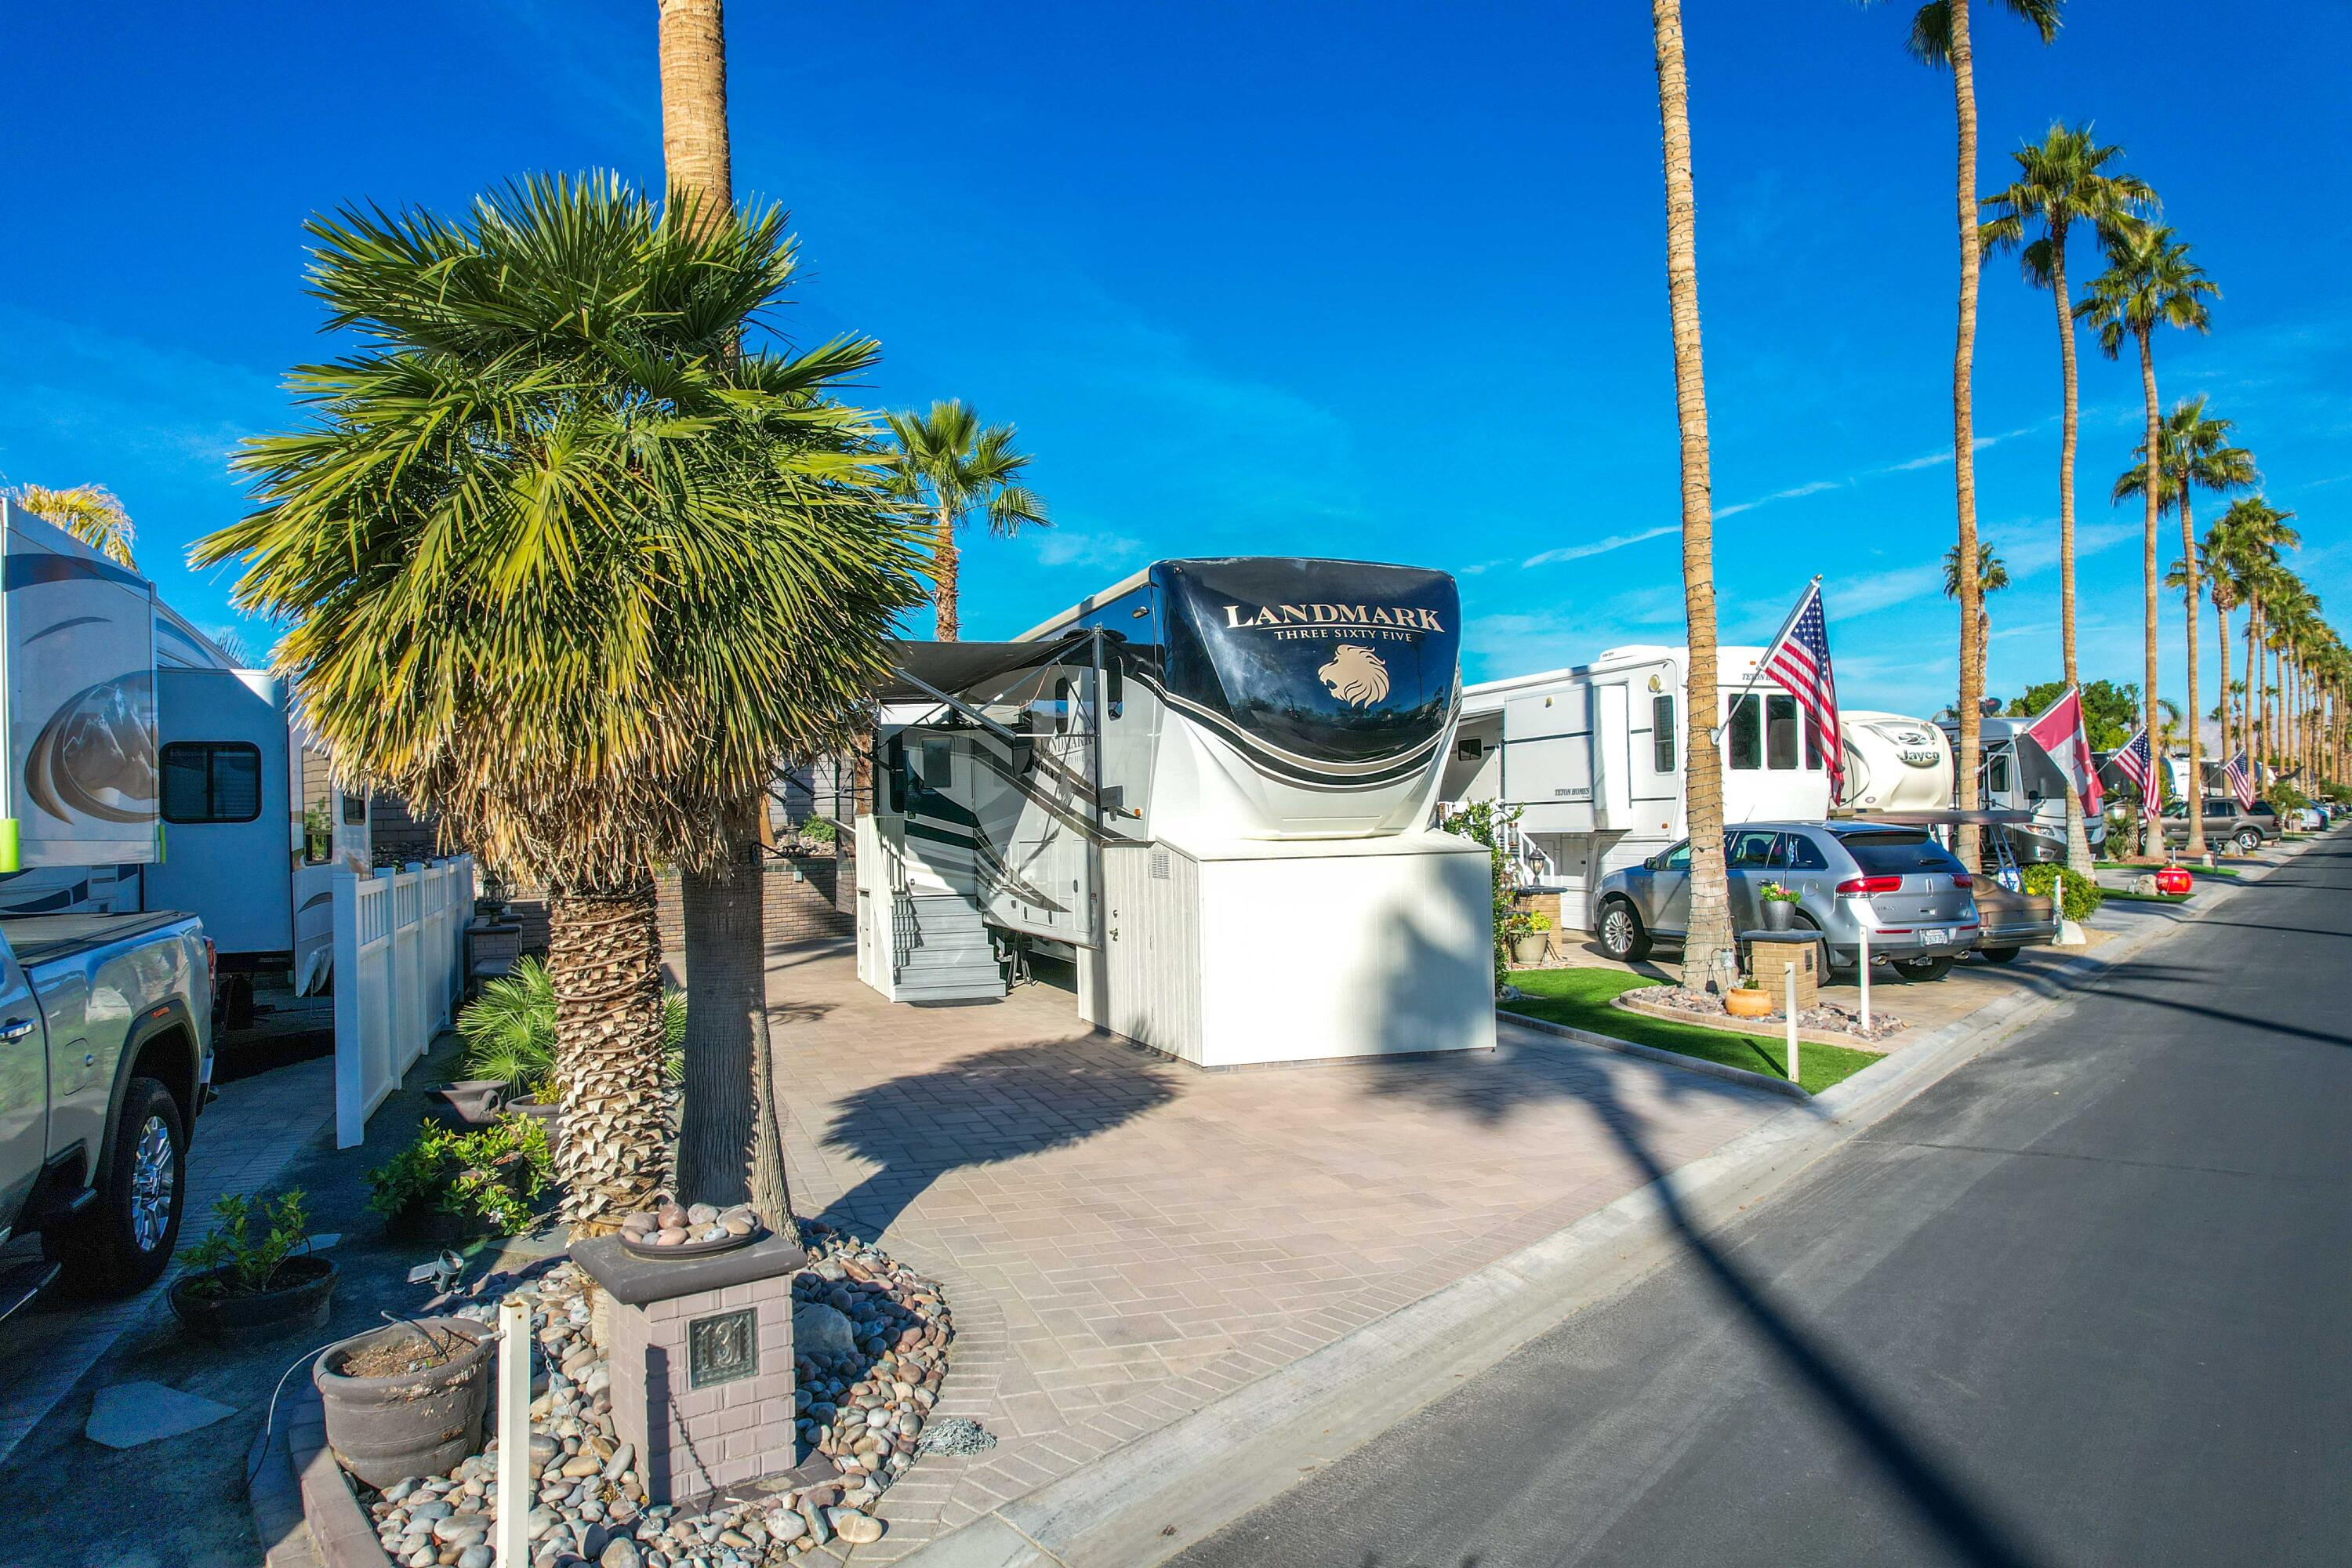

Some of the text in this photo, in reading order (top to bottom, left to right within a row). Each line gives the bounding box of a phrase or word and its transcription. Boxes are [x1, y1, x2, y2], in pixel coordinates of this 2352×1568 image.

[1222, 603, 1445, 633] LANDMARK
[1274, 629, 1413, 642] THREE SIXTY FIVE
[1898, 750, 1940, 762] Jayco
[700, 1316, 743, 1373] 131
